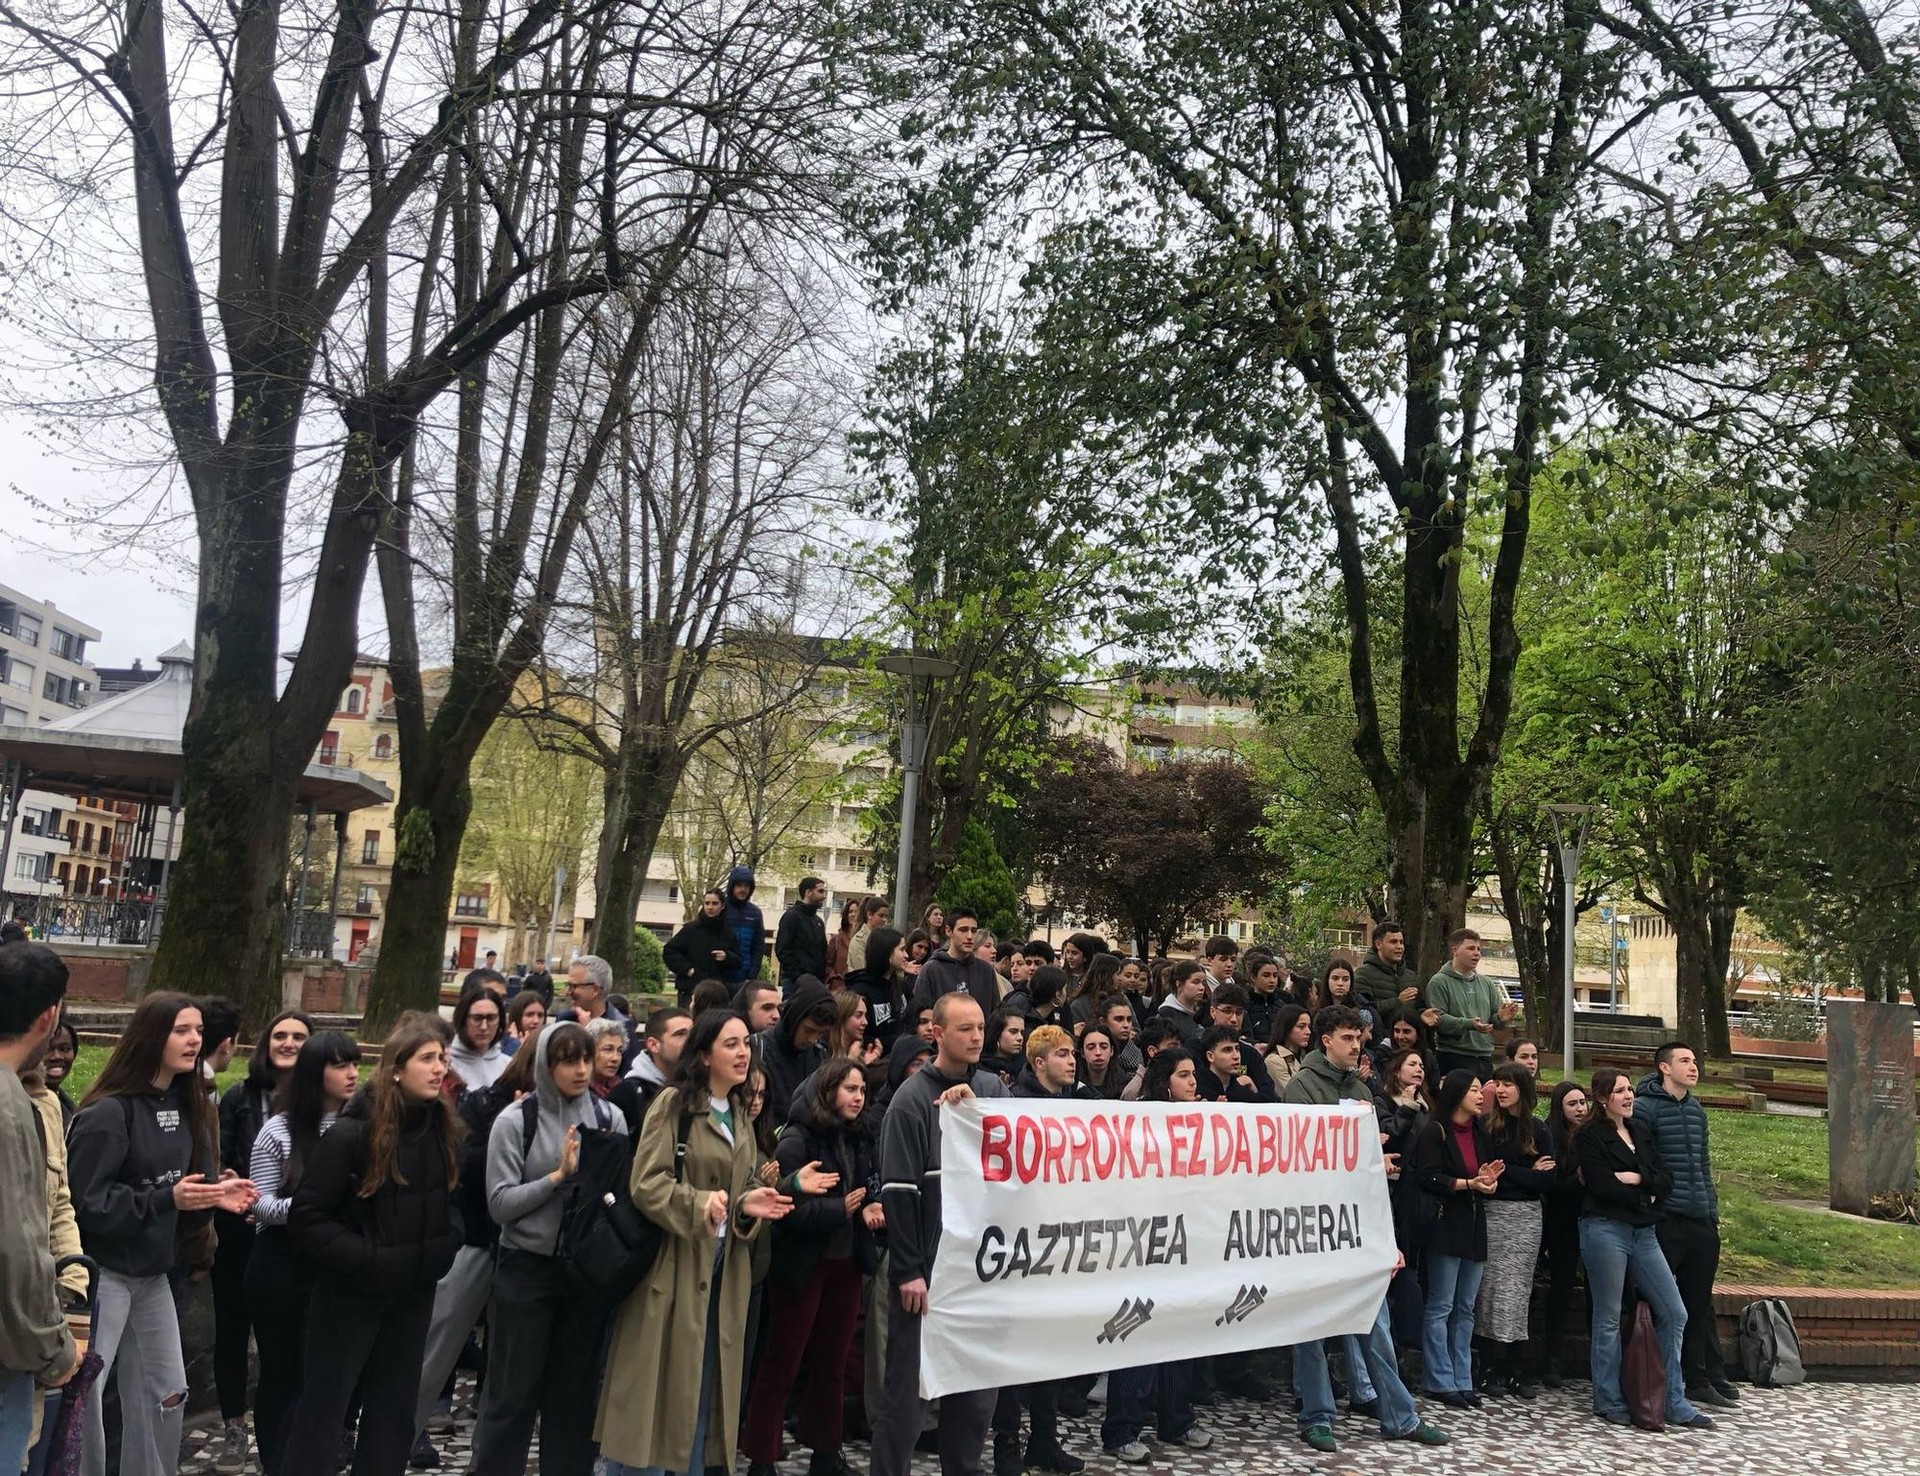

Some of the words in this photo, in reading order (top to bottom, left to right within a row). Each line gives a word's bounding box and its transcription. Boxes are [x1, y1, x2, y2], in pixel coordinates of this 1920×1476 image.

[981, 1114, 1164, 1184] BORROKA
[1166, 1113, 1207, 1177] EZ
[1210, 1113, 1253, 1177] DA
[1256, 1113, 1359, 1177] BUKATU
[975, 1213, 1188, 1283] GAZTETXEA
[1223, 1203, 1362, 1262] AURRERA!
